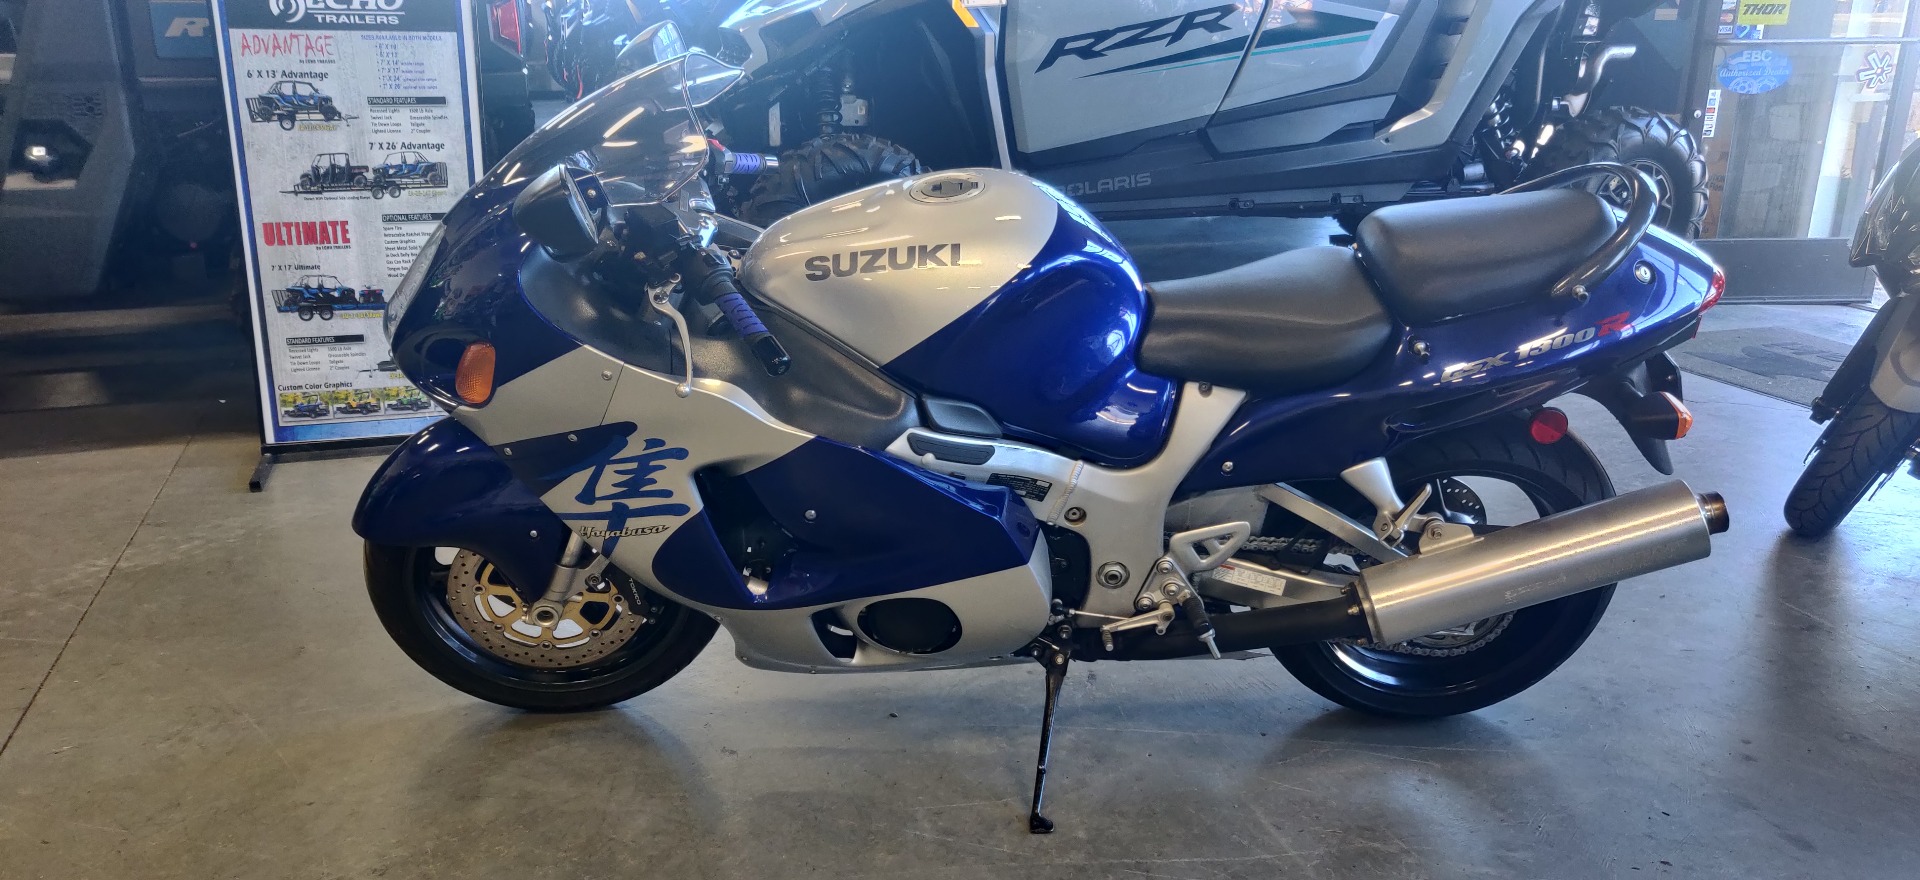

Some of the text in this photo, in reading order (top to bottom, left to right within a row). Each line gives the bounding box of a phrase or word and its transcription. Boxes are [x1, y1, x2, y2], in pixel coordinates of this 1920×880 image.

[1743, 4, 1787, 15] THOR
[314, 15, 399, 24] TRAILERS
[1034, 3, 1241, 74] RZR
[241, 32, 334, 58] ADVANTAGE
[1742, 50, 1773, 62] EBC
[257, 70, 263, 78] X
[280, 70, 328, 81] Advantage
[1720, 69, 1761, 77] Authorized
[378, 142, 384, 150] X
[401, 142, 445, 152] Advantage
[262, 221, 350, 246] ULTIMATE
[804, 243, 961, 281] SUZUKI
[325, 381, 353, 390] Graphics
[579, 524, 671, 540] Hayabusa
[628, 578, 642, 606] TOKICO
